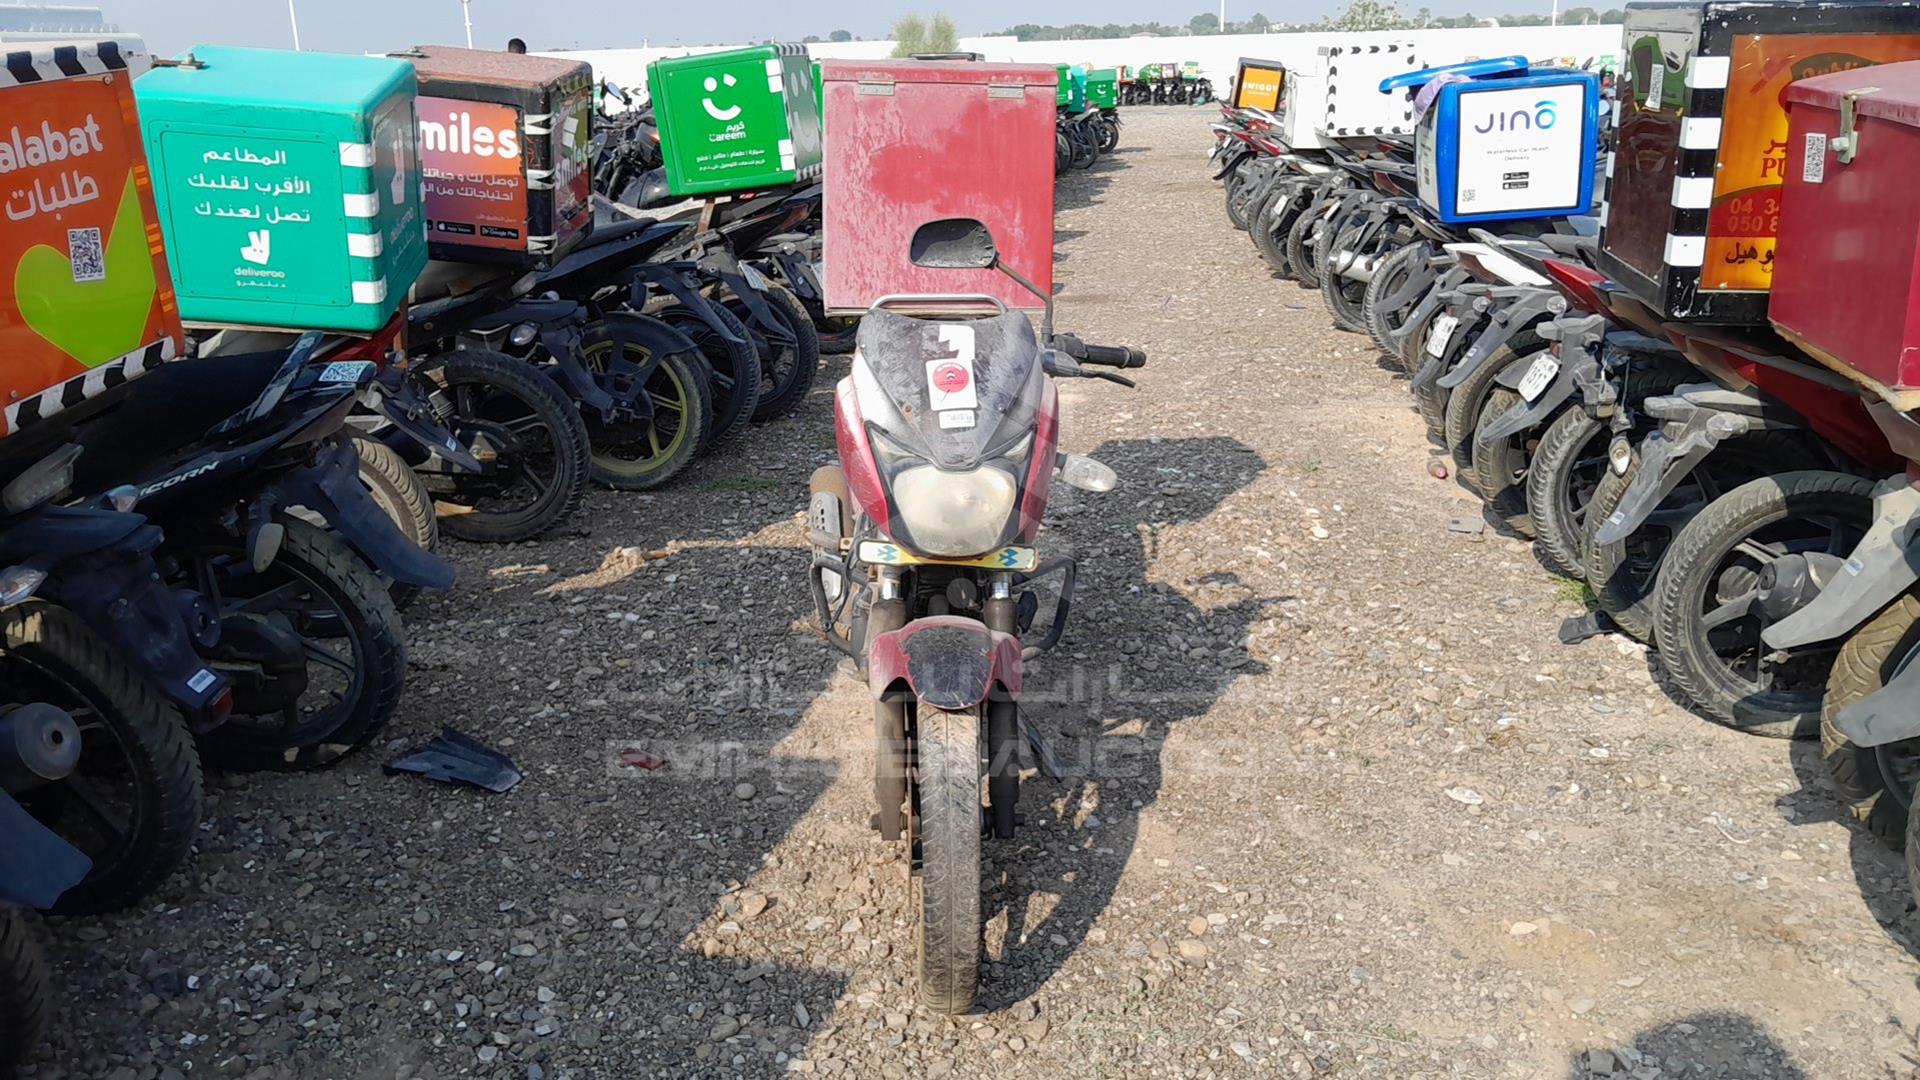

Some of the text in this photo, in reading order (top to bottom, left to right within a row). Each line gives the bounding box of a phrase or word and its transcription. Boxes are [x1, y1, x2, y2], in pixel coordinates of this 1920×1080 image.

[0, 114, 104, 174] alabat
[420, 112, 519, 159] miles
[202, 147, 287, 166] المطاعم
[5, 169, 100, 222] طلبات
[187, 173, 311, 196] الأقرب لقلبك
[436, 184, 455, 196] من
[194, 201, 311, 225] تصل لعندك
[1729, 198, 1754, 214] 04
[1727, 215, 1764, 232] 050
[1725, 242, 1758, 265] هيل
[233, 266, 286, 279] deliveroo
[140, 460, 220, 497] ICORN
